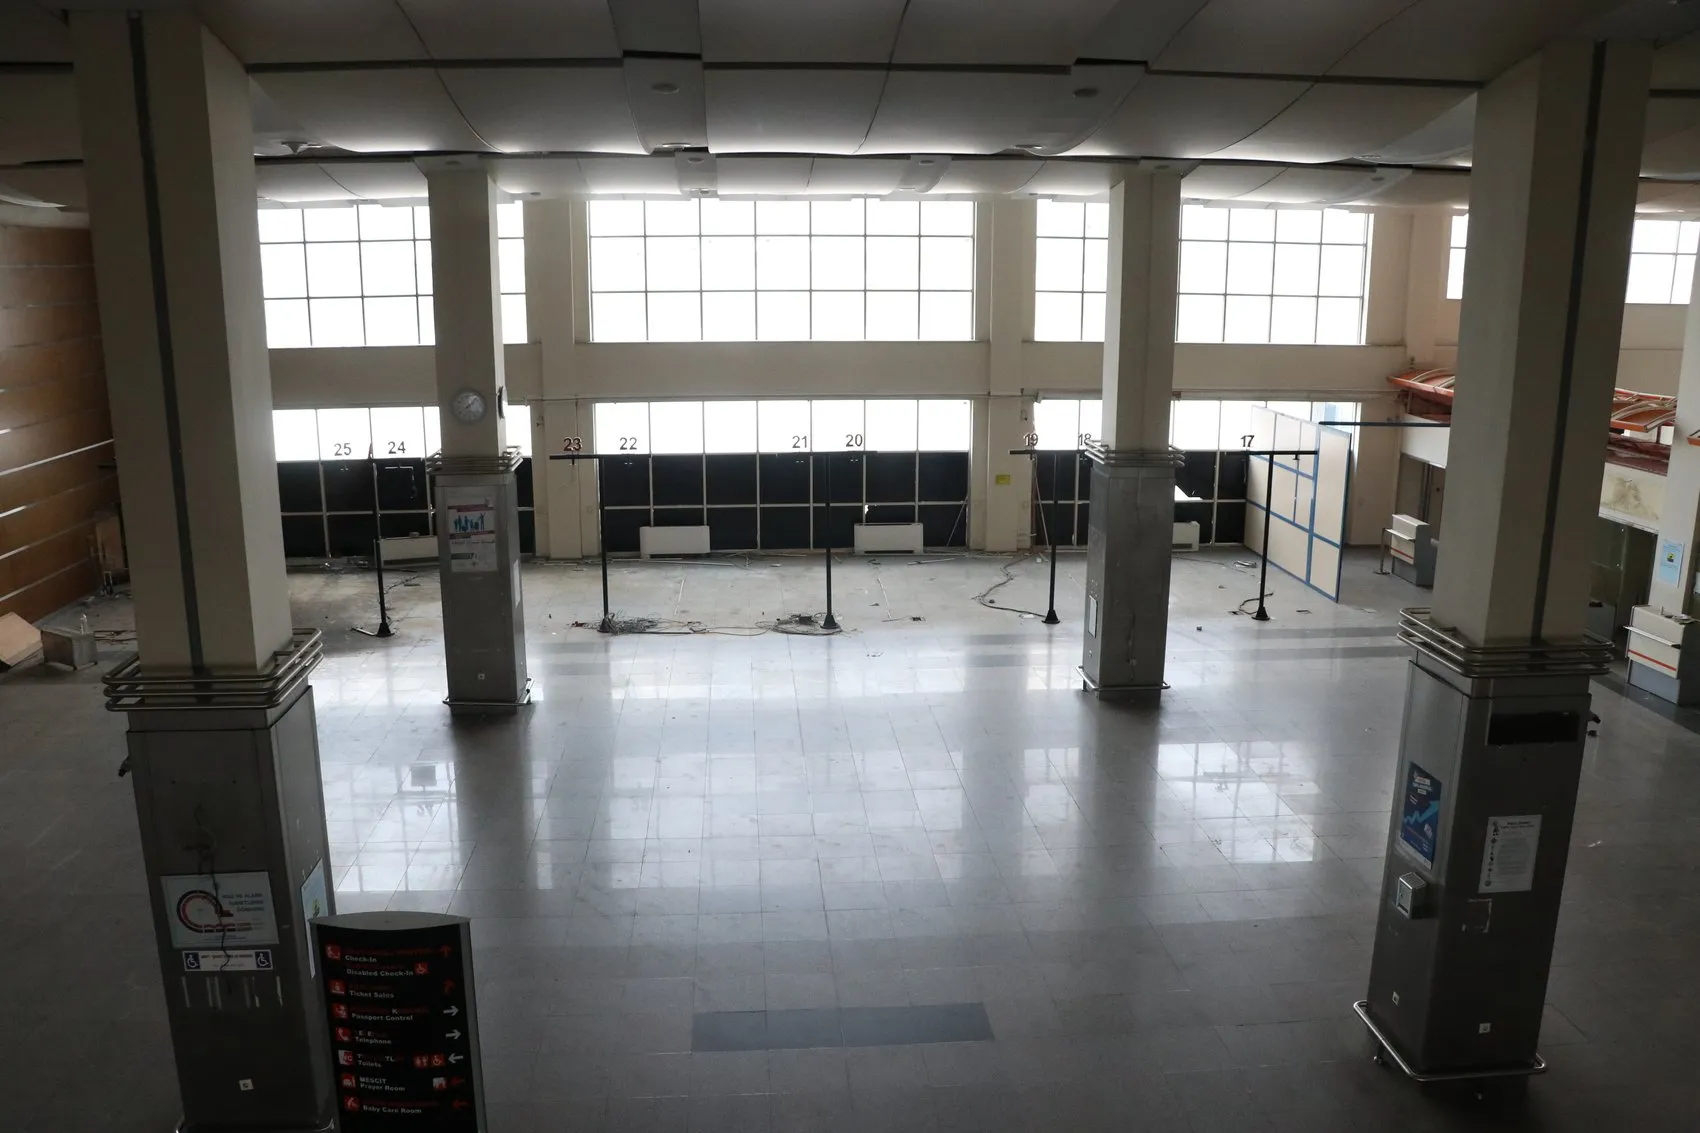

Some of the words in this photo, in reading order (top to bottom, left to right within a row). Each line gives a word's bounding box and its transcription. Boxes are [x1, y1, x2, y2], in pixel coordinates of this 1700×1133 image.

[563, 438, 582, 452] 23
[619, 437, 637, 450] 22
[792, 436, 807, 448] 21
[845, 434, 863, 447] 20
[1024, 433, 1039, 446] 19
[1078, 433, 1092, 446] 18
[1240, 435, 1255, 447] 17
[334, 443, 352, 456] 25
[388, 441, 406, 454] 24
[346, 968, 378, 976] Disabled
[349, 990, 371, 998] Ticket
[373, 991, 395, 999] Sales
[351, 1012, 384, 1021] Passport
[354, 1036, 392, 1045] Telephone
[357, 1059, 382, 1068] Toilets
[359, 1083, 383, 1091] Prayer
[362, 1104, 380, 1113] Baby
